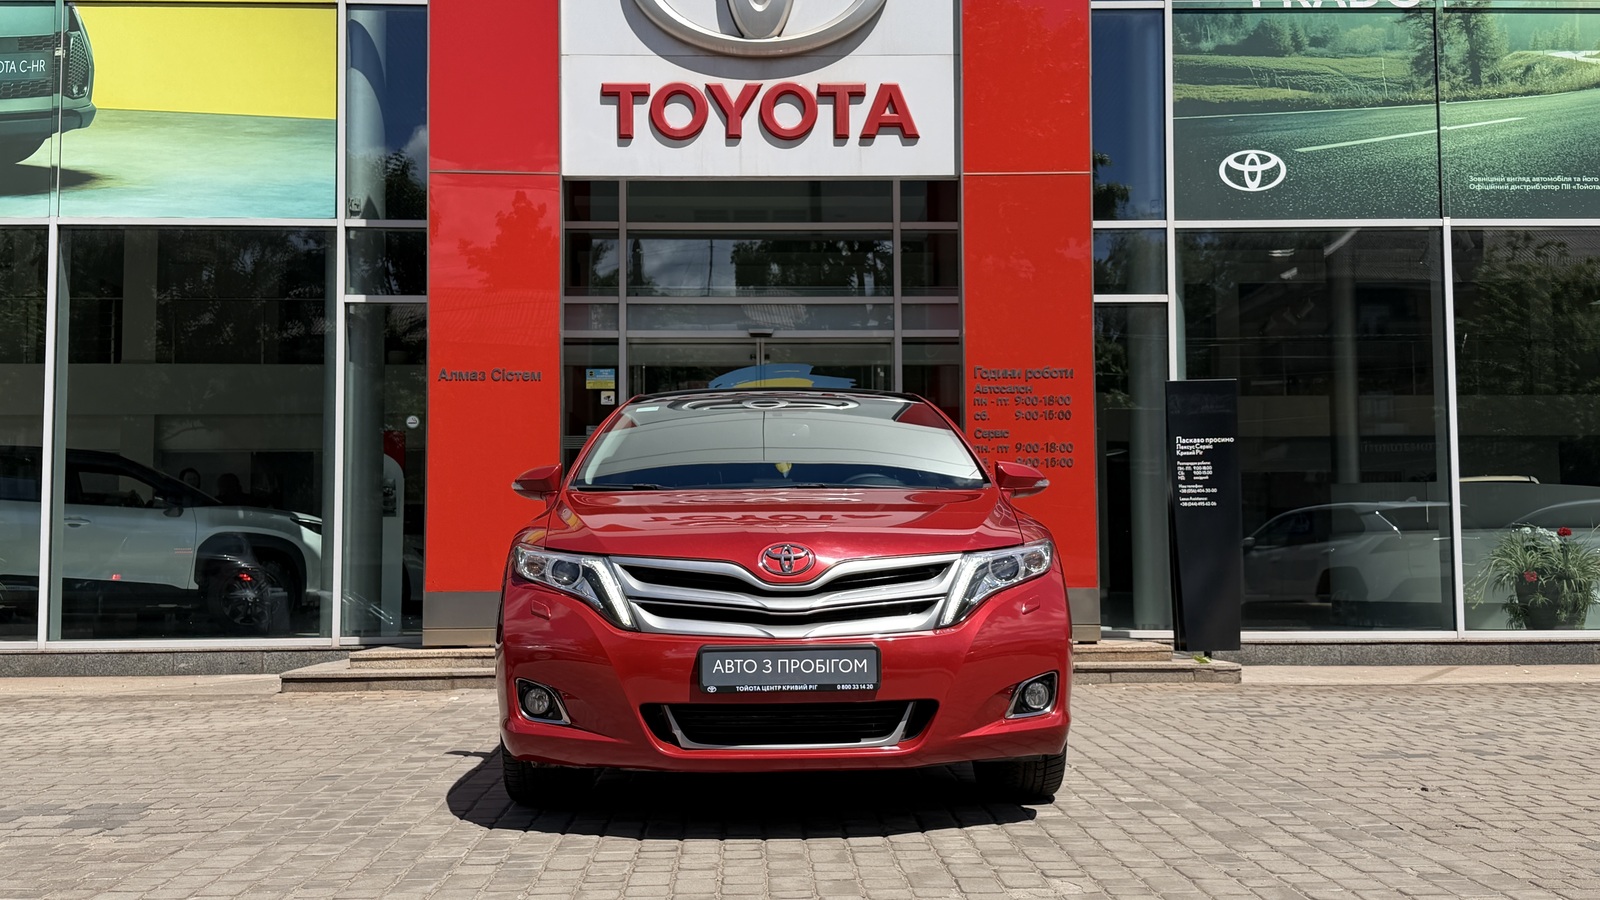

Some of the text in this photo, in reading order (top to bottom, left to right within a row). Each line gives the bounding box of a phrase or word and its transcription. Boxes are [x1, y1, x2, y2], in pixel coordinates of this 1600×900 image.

[20, 60, 46, 73] C-HR
[600, 81, 921, 141] TOYOTA
[1506, 175, 1531, 183] вигляд
[1532, 174, 1572, 182] автомобіля
[1582, 174, 1599, 183] його
[1469, 182, 1509, 191] Офіційний
[438, 368, 542, 382] Алмаз Сістем
[974, 366, 1074, 382] Години роботи
[974, 384, 1033, 394] Автосалон
[1014, 395, 1072, 406] 9:00-18:00
[974, 411, 990, 421] сб.
[974, 427, 1011, 441] Сервіс
[1015, 442, 1074, 453] 9:00-18:00
[713, 658, 868, 674] АВТО З ПРОБІГОМ
[736, 684, 761, 692] ТОЙОТА
